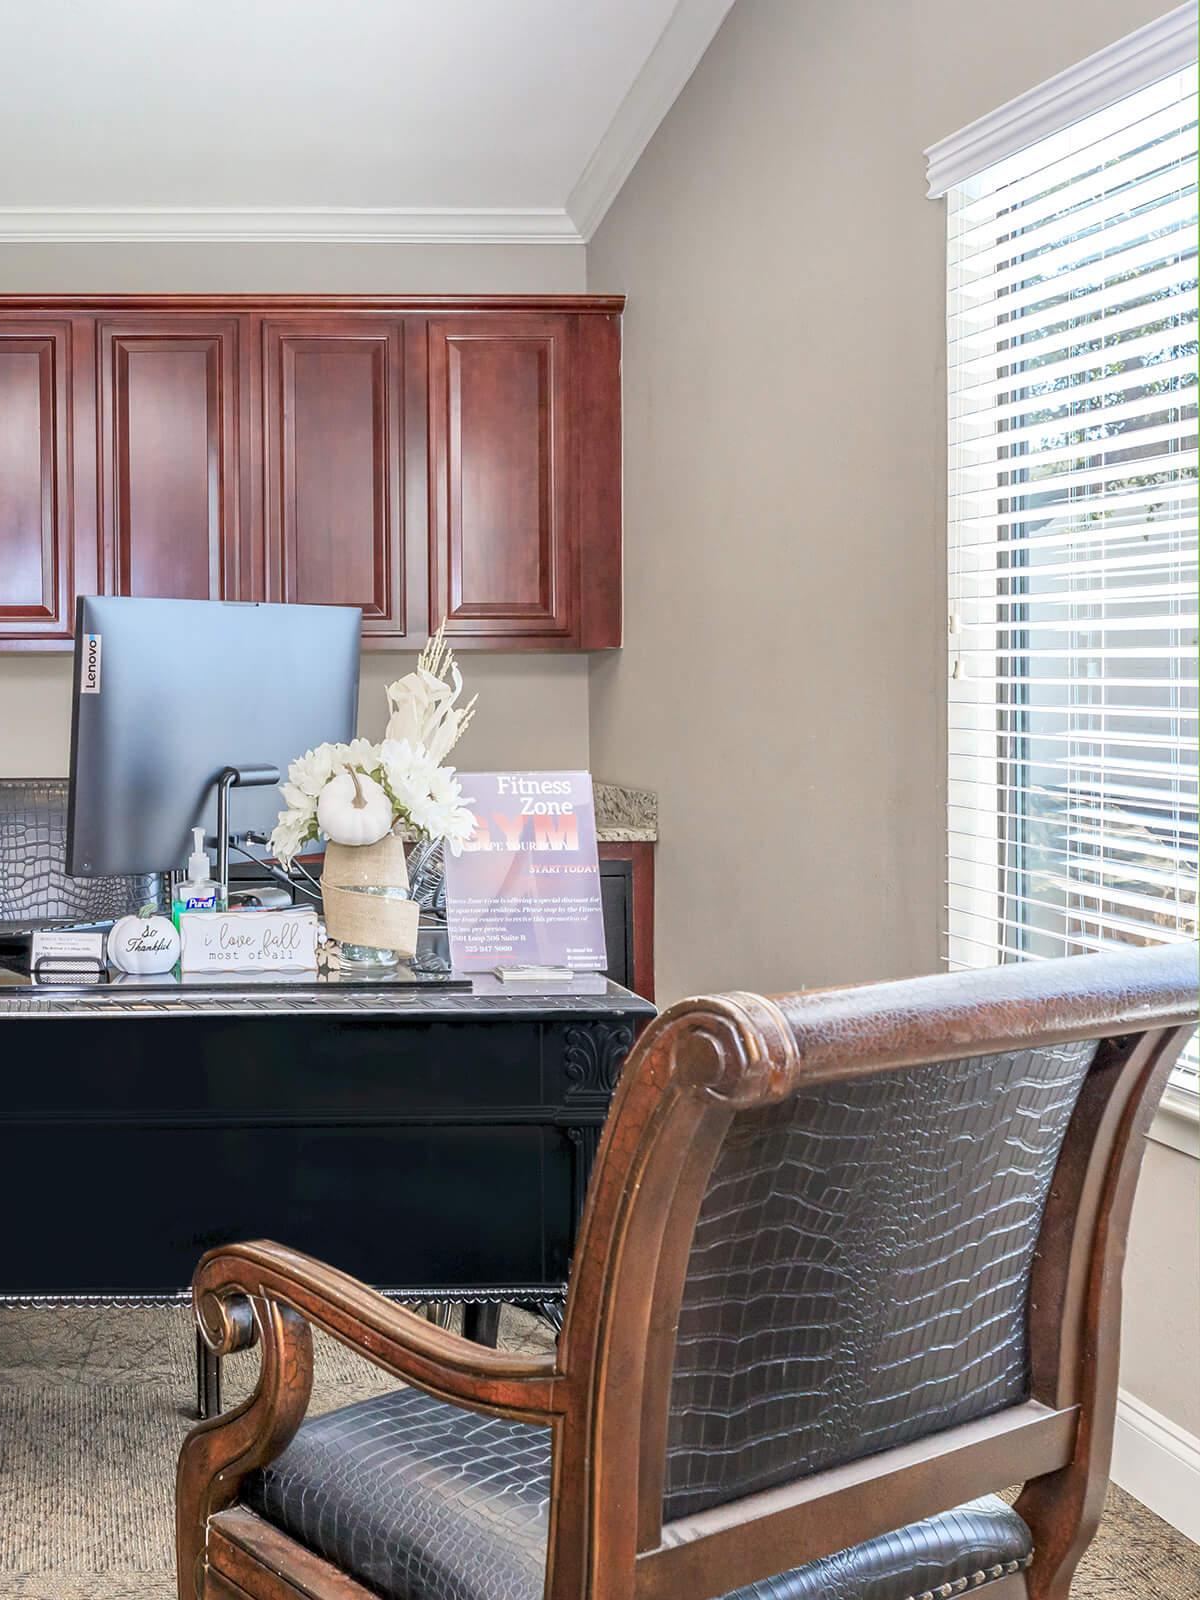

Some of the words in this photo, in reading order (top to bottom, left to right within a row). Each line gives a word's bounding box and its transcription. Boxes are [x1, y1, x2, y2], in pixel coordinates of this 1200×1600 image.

[86, 640, 97, 688] Lenovo
[497, 776, 572, 795] Fitness
[520, 797, 574, 816] Zone
[528, 864, 561, 874] START
[563, 864, 598, 874] TODAY
[189, 899, 214, 909] Purell
[125, 937, 173, 955] Thankful
[220, 922, 255, 950] love
[263, 922, 301, 957] fall
[209, 950, 240, 960] most
[249, 950, 263, 960] of
[272, 950, 294, 960] all
